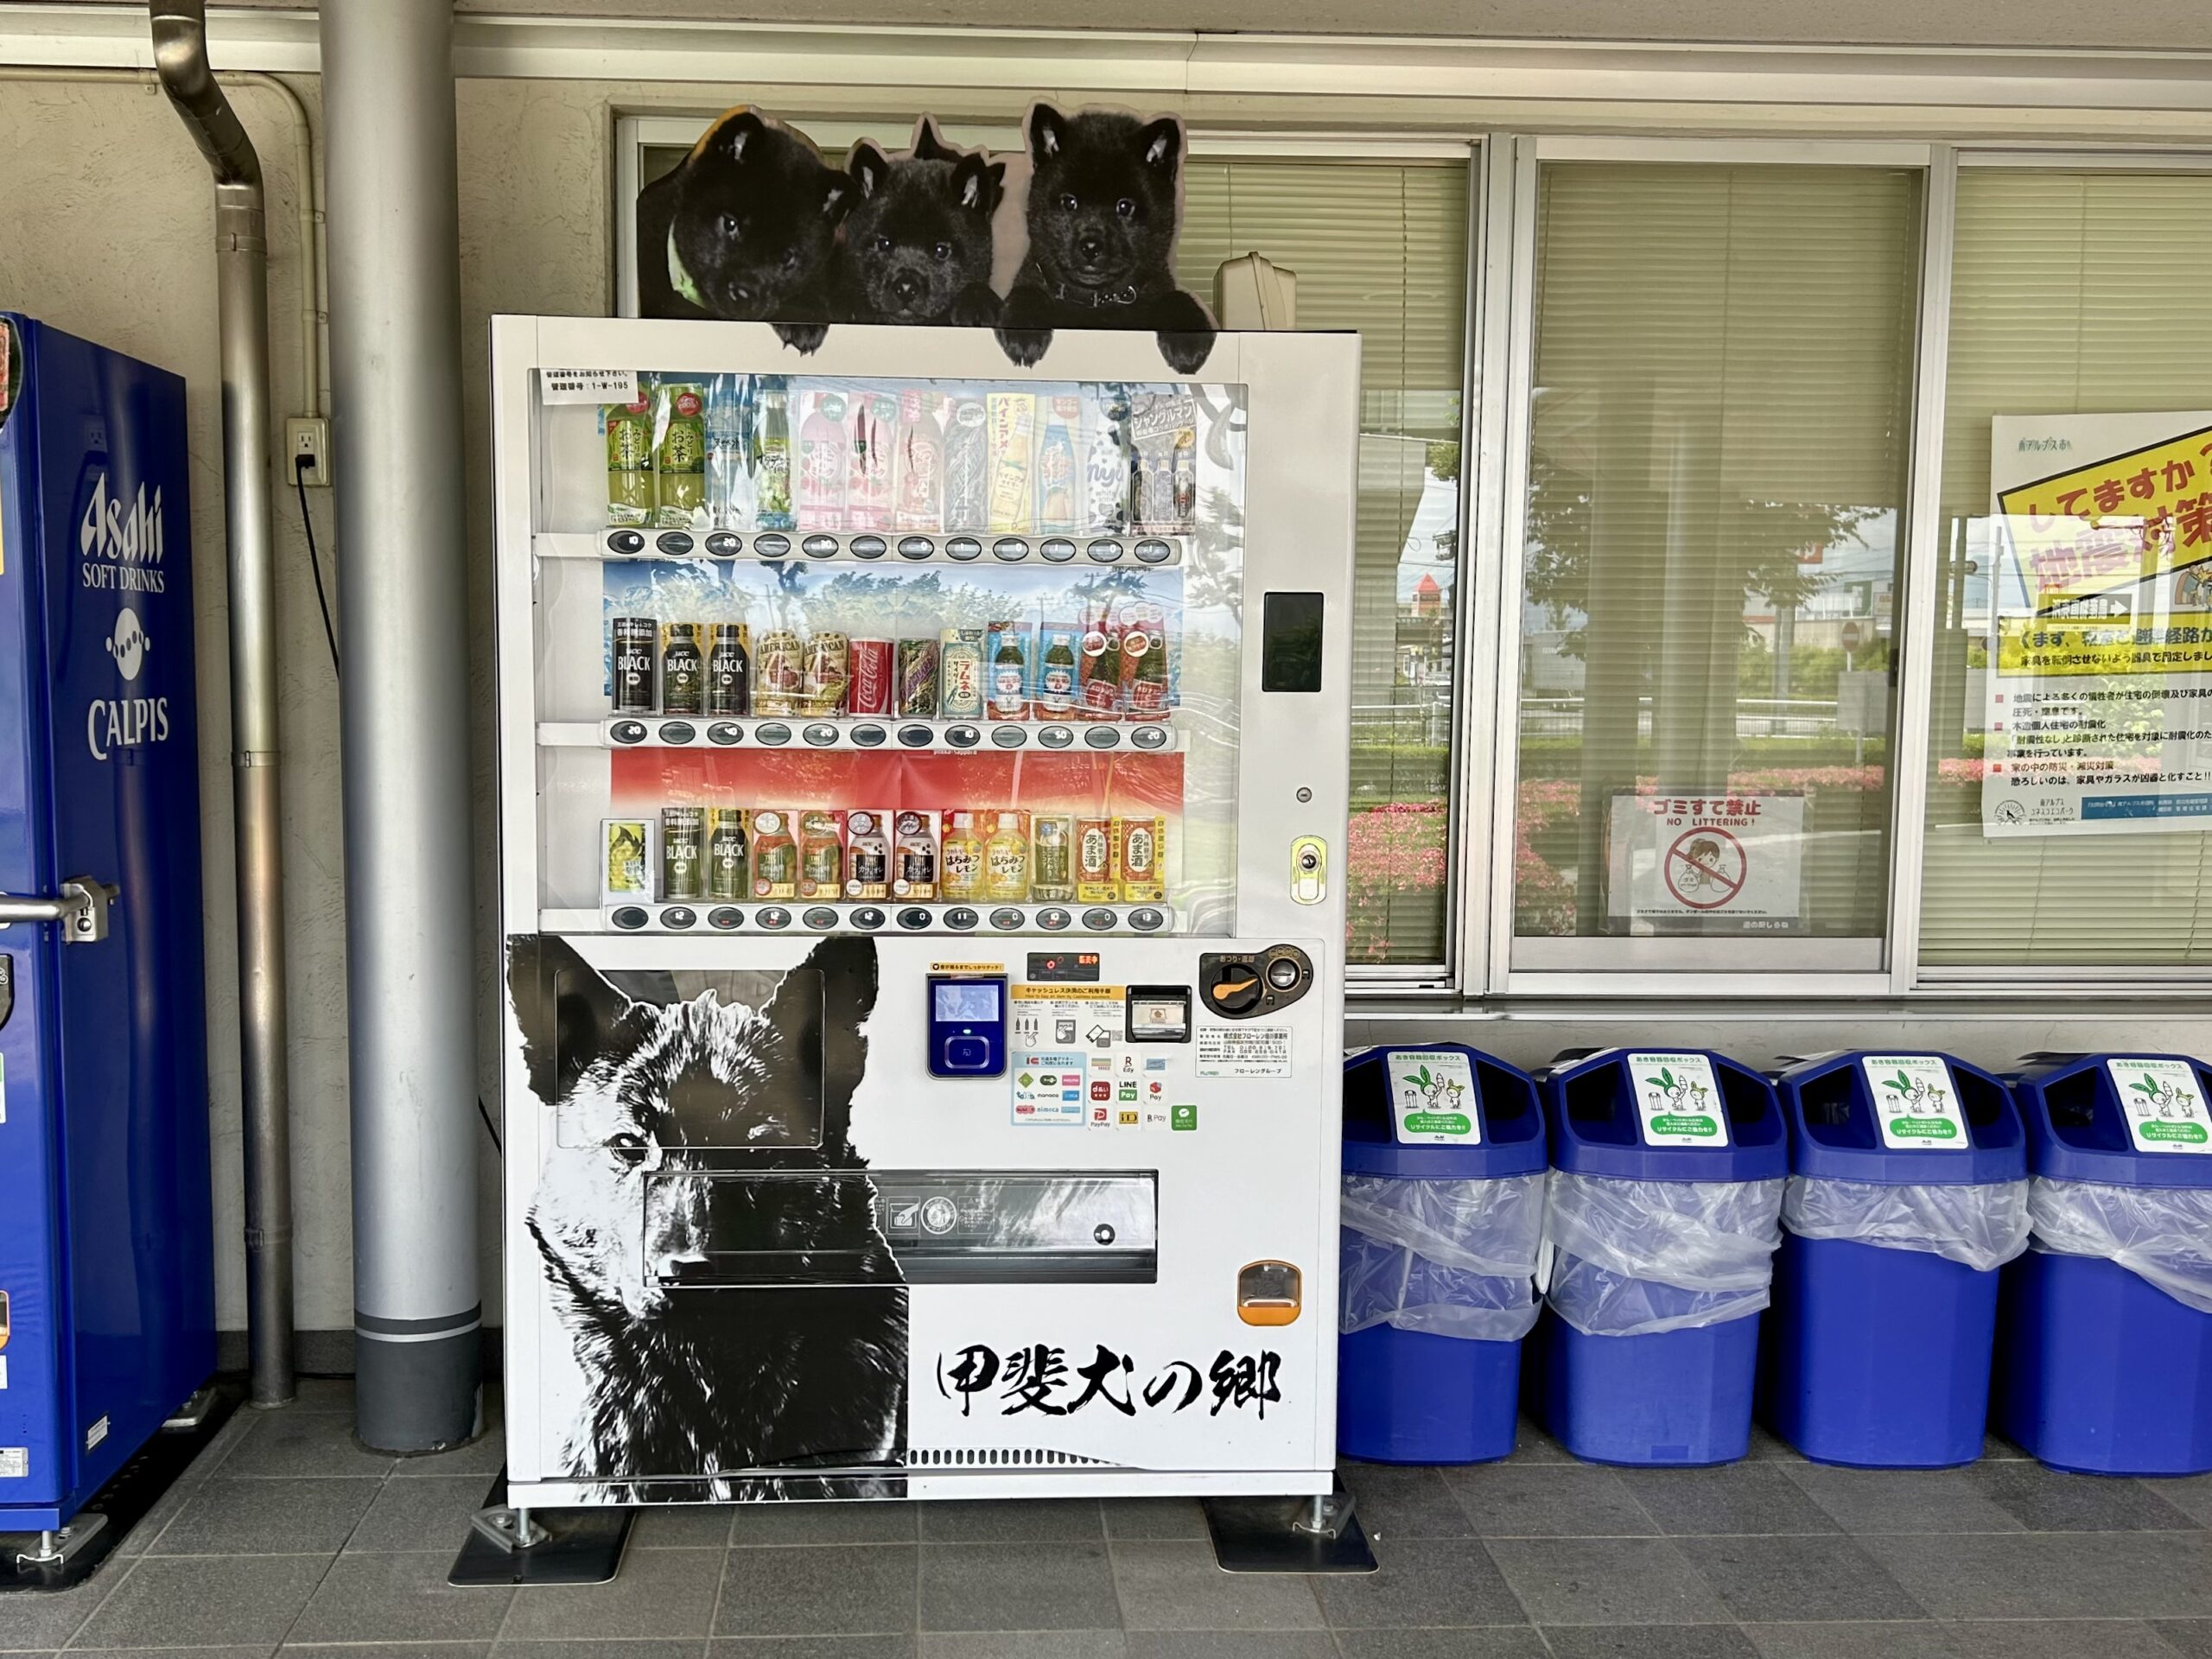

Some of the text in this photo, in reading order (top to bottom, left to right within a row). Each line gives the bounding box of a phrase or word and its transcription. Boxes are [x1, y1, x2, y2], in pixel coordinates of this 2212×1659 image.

[671, 430, 687, 462] お茶
[81, 472, 164, 563] Asahi
[82, 562, 165, 594] SOFT DRINKS
[759, 640, 800, 655] AMERICAN
[618, 656, 651, 671] BLACK
[667, 658, 697, 672] BLACK
[713, 659, 743, 673] BLACK
[959, 660, 971, 691] ラムネ
[87, 696, 169, 761] CALPIS
[1653, 798, 1762, 817] ゴミすて禁止
[1666, 817, 1682, 826] NO
[1692, 817, 1748, 827] LITTERING
[665, 845, 697, 860] BLACK
[714, 842, 744, 857] BLACK
[1085, 834, 1097, 868] あま酒
[1132, 833, 1143, 868] あま酒
[945, 855, 980, 866] はちみつ
[990, 855, 1026, 866] はちみつ
[956, 865, 978, 874] レモン
[1001, 865, 1024, 874] レモン
[1154, 1114, 1166, 1122] Pay
[936, 1342, 1282, 1421] 甲斐犬の郷
